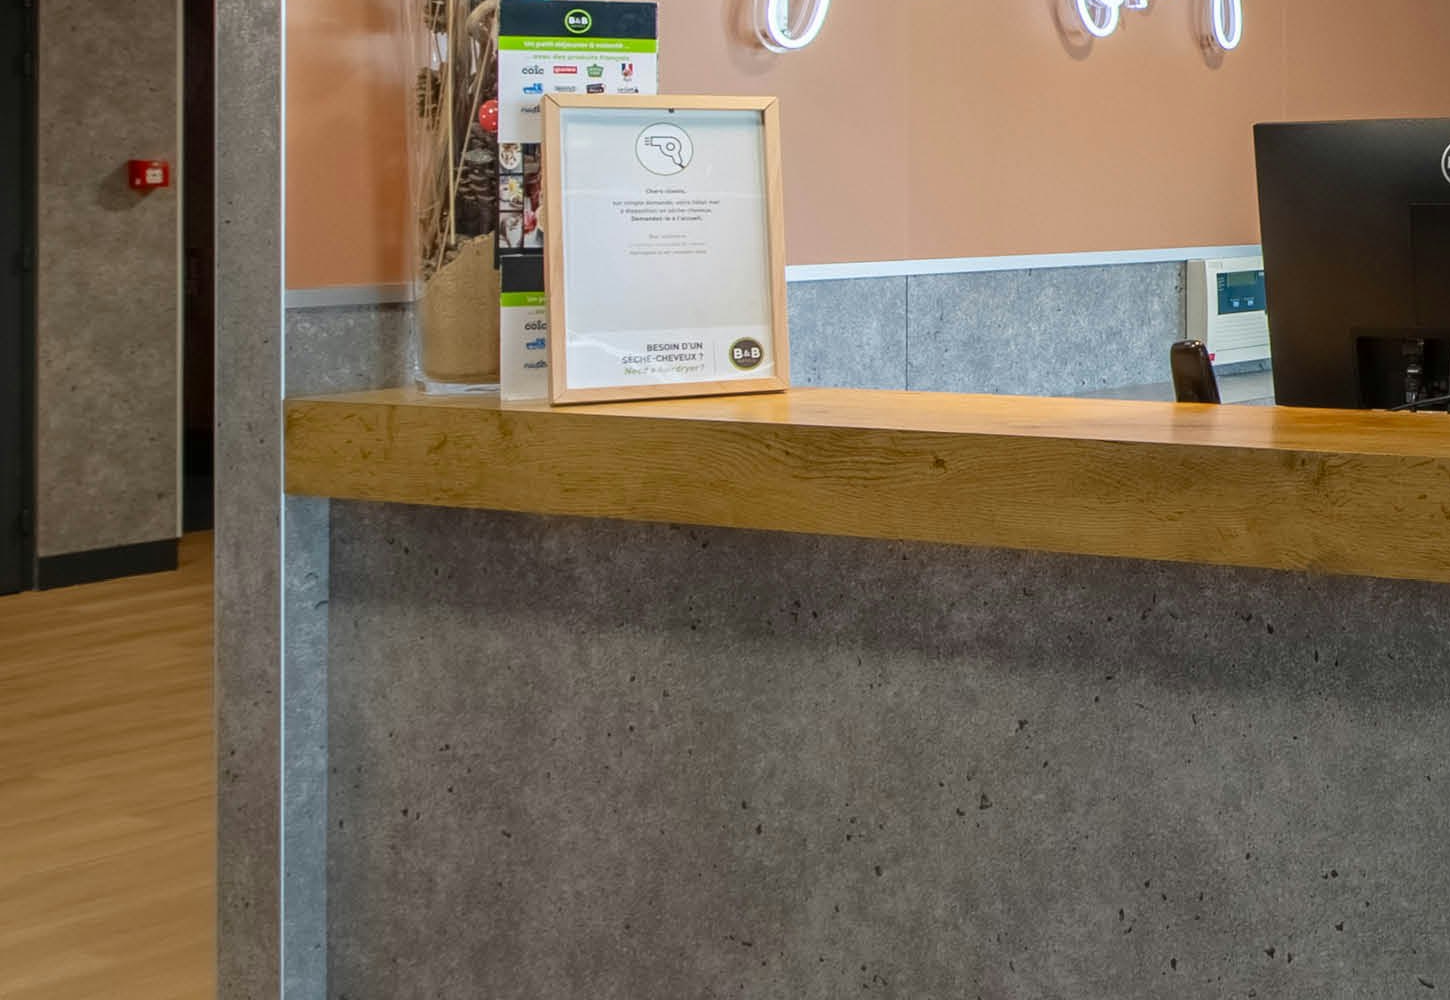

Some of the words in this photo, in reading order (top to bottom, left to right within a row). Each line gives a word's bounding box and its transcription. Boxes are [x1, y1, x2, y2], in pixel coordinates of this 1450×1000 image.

[568, 15, 588, 25] B&B
[646, 343, 680, 352] BESOIN
[681, 341, 704, 351] D'UN
[732, 347, 761, 360] B&B
